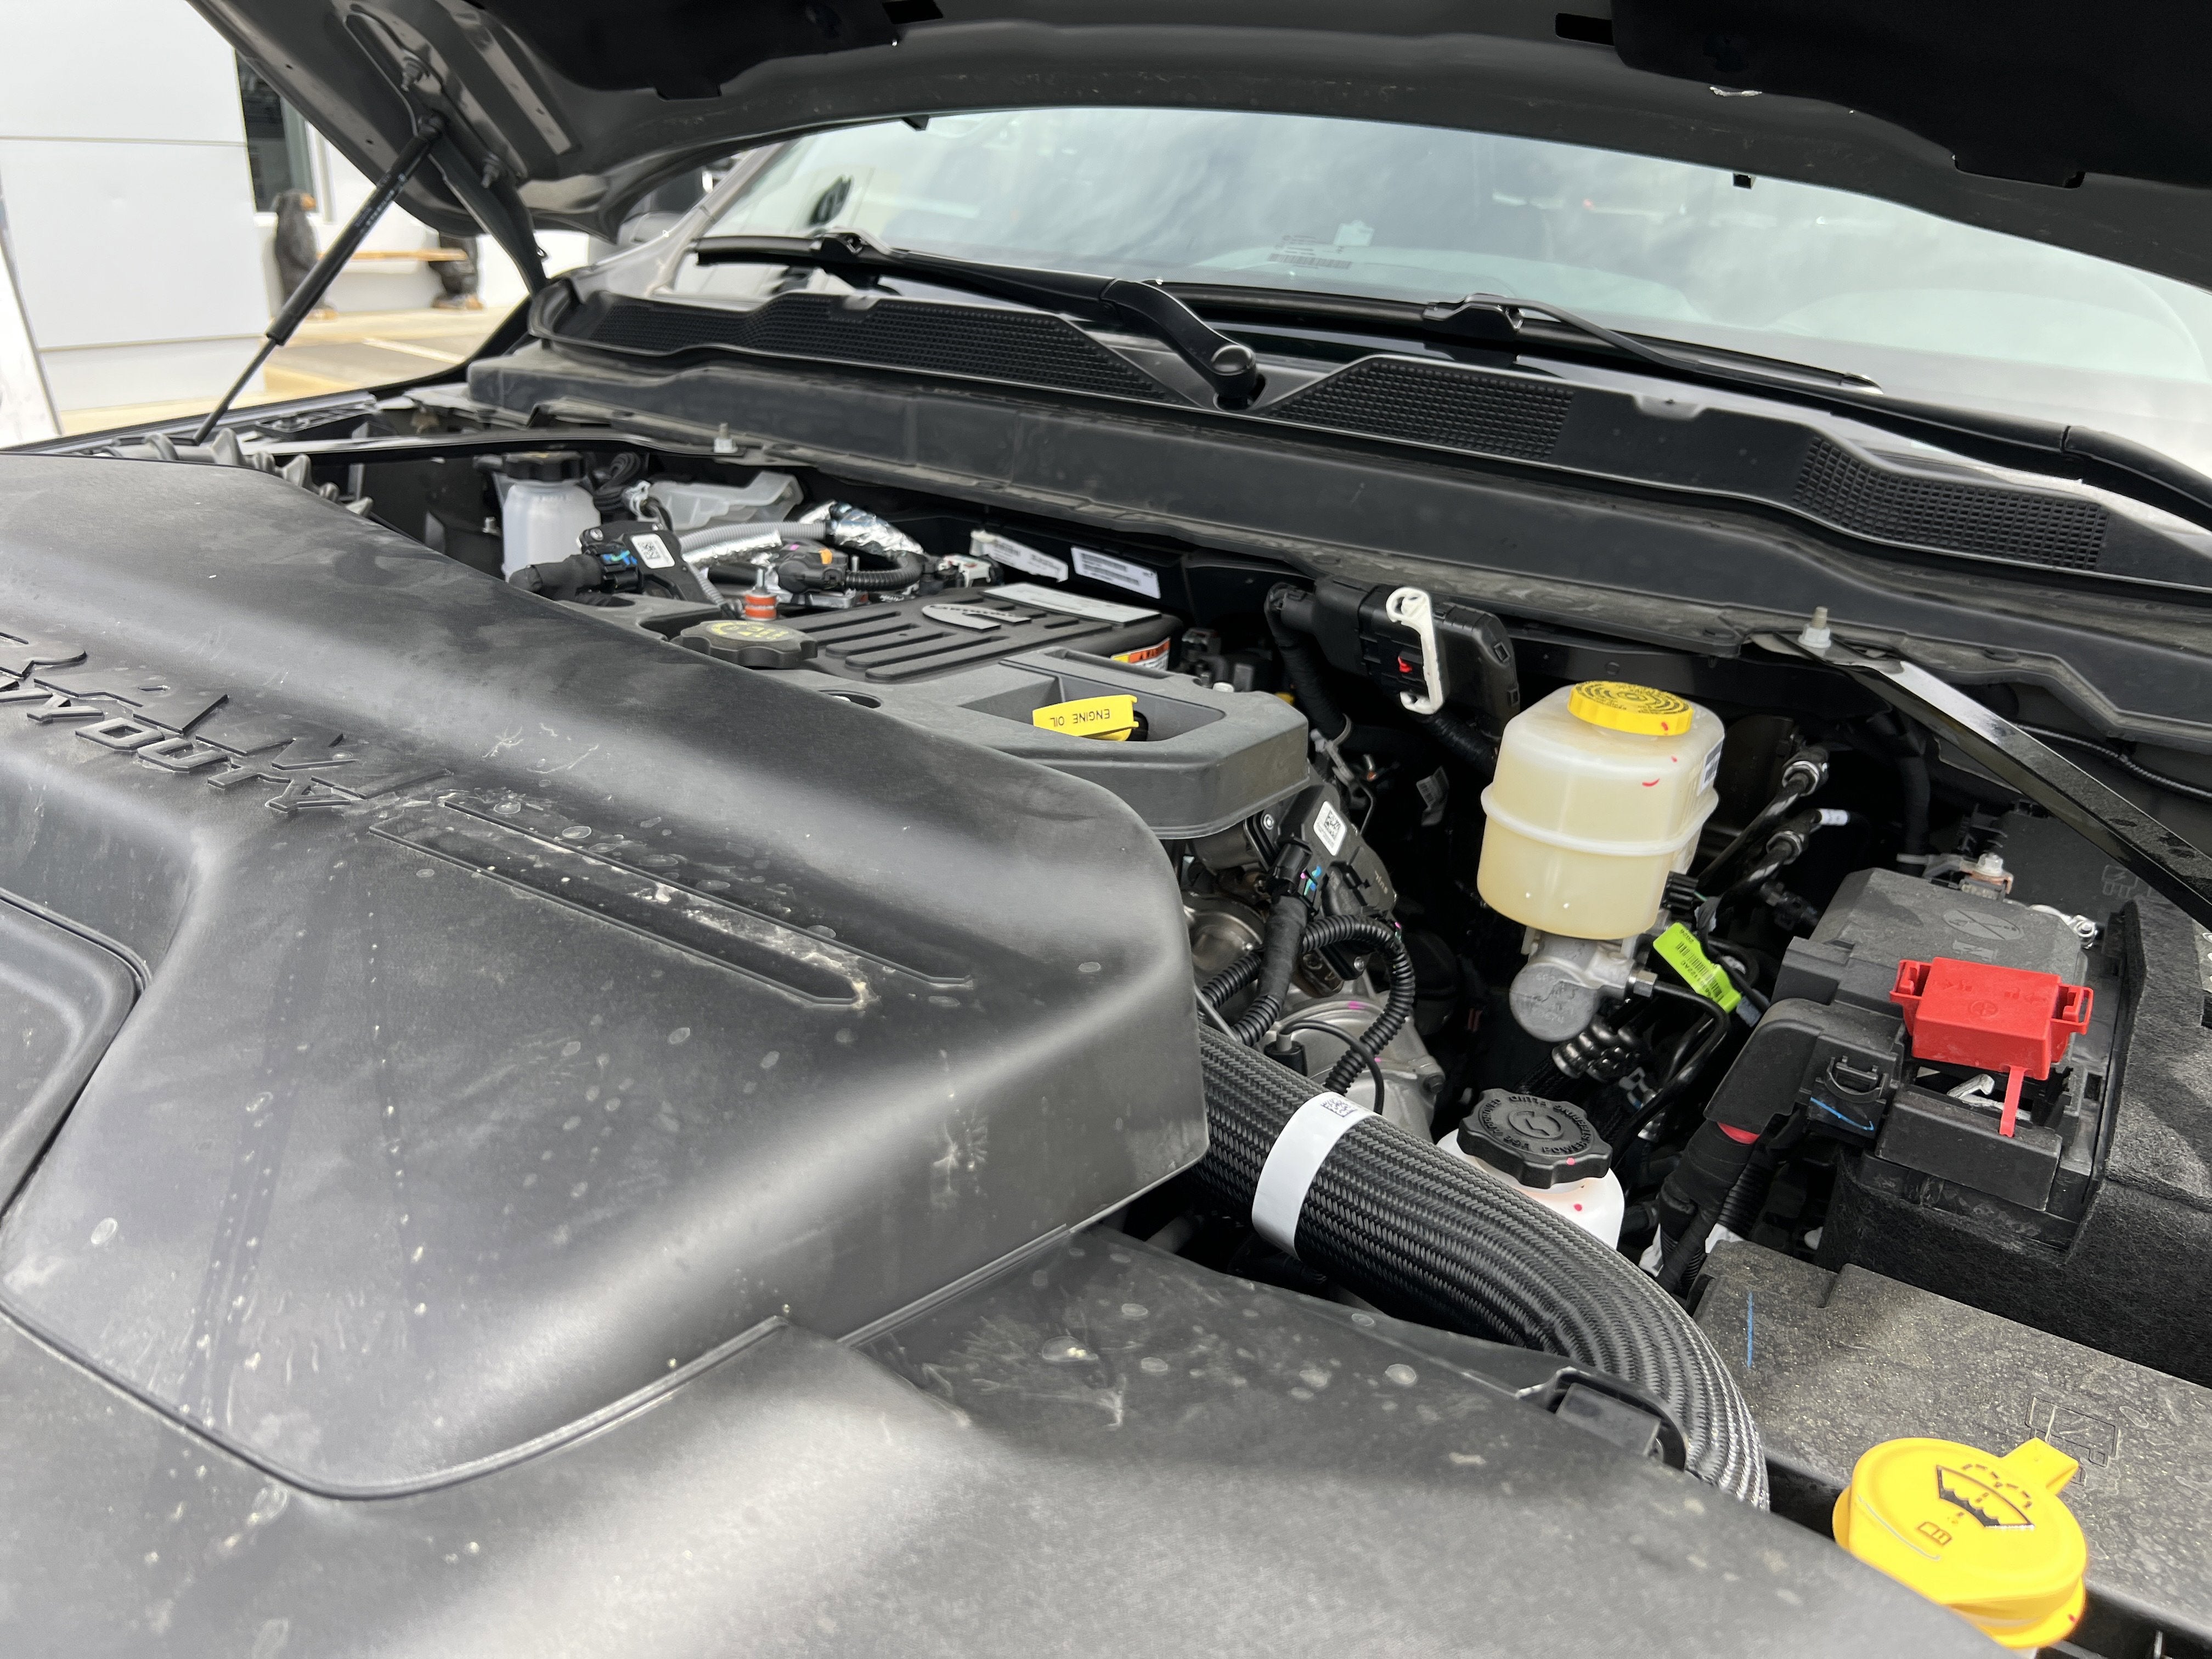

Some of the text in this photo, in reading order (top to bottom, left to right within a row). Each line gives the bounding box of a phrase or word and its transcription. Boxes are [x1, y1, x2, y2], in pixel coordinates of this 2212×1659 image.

[1050, 709, 1110, 727] ENGINE OIL
[75, 716, 352, 813] DUTY
[1481, 1099, 1532, 1152] USE APPROVED
[1509, 1096, 1592, 1154] POWER STEERING FLUID
